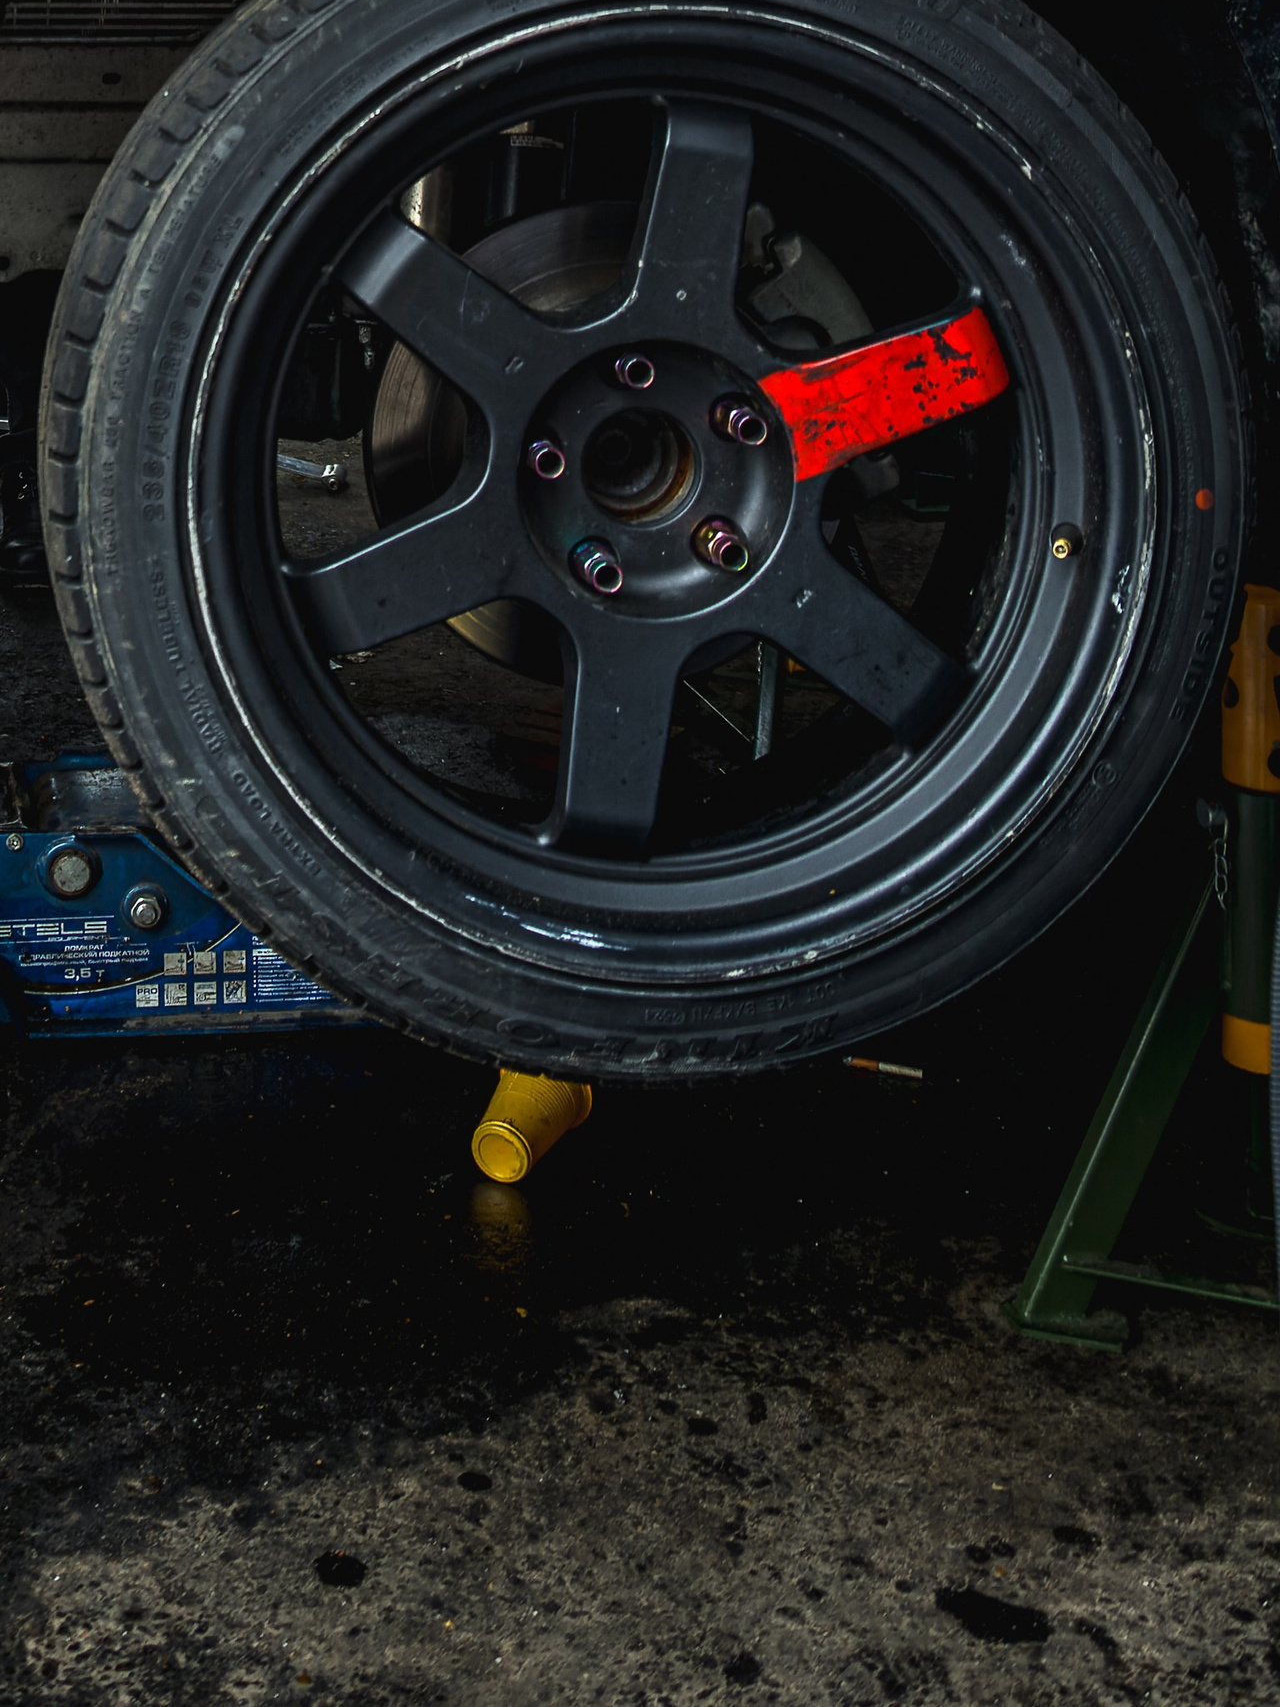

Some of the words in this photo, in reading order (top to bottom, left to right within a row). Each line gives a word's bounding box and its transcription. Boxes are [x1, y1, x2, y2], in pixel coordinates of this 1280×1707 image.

[146, 569, 190, 677] TUBELESS
[1165, 544, 1231, 724] OUTSIDE
[176, 678, 225, 756] RADIAL
[227, 769, 273, 823] LOAD
[266, 820, 325, 879] EXTRA
[64, 944, 105, 953] ДОМКРАТ
[64, 967, 91, 982] 3,5
[137, 987, 158, 996] PRO
